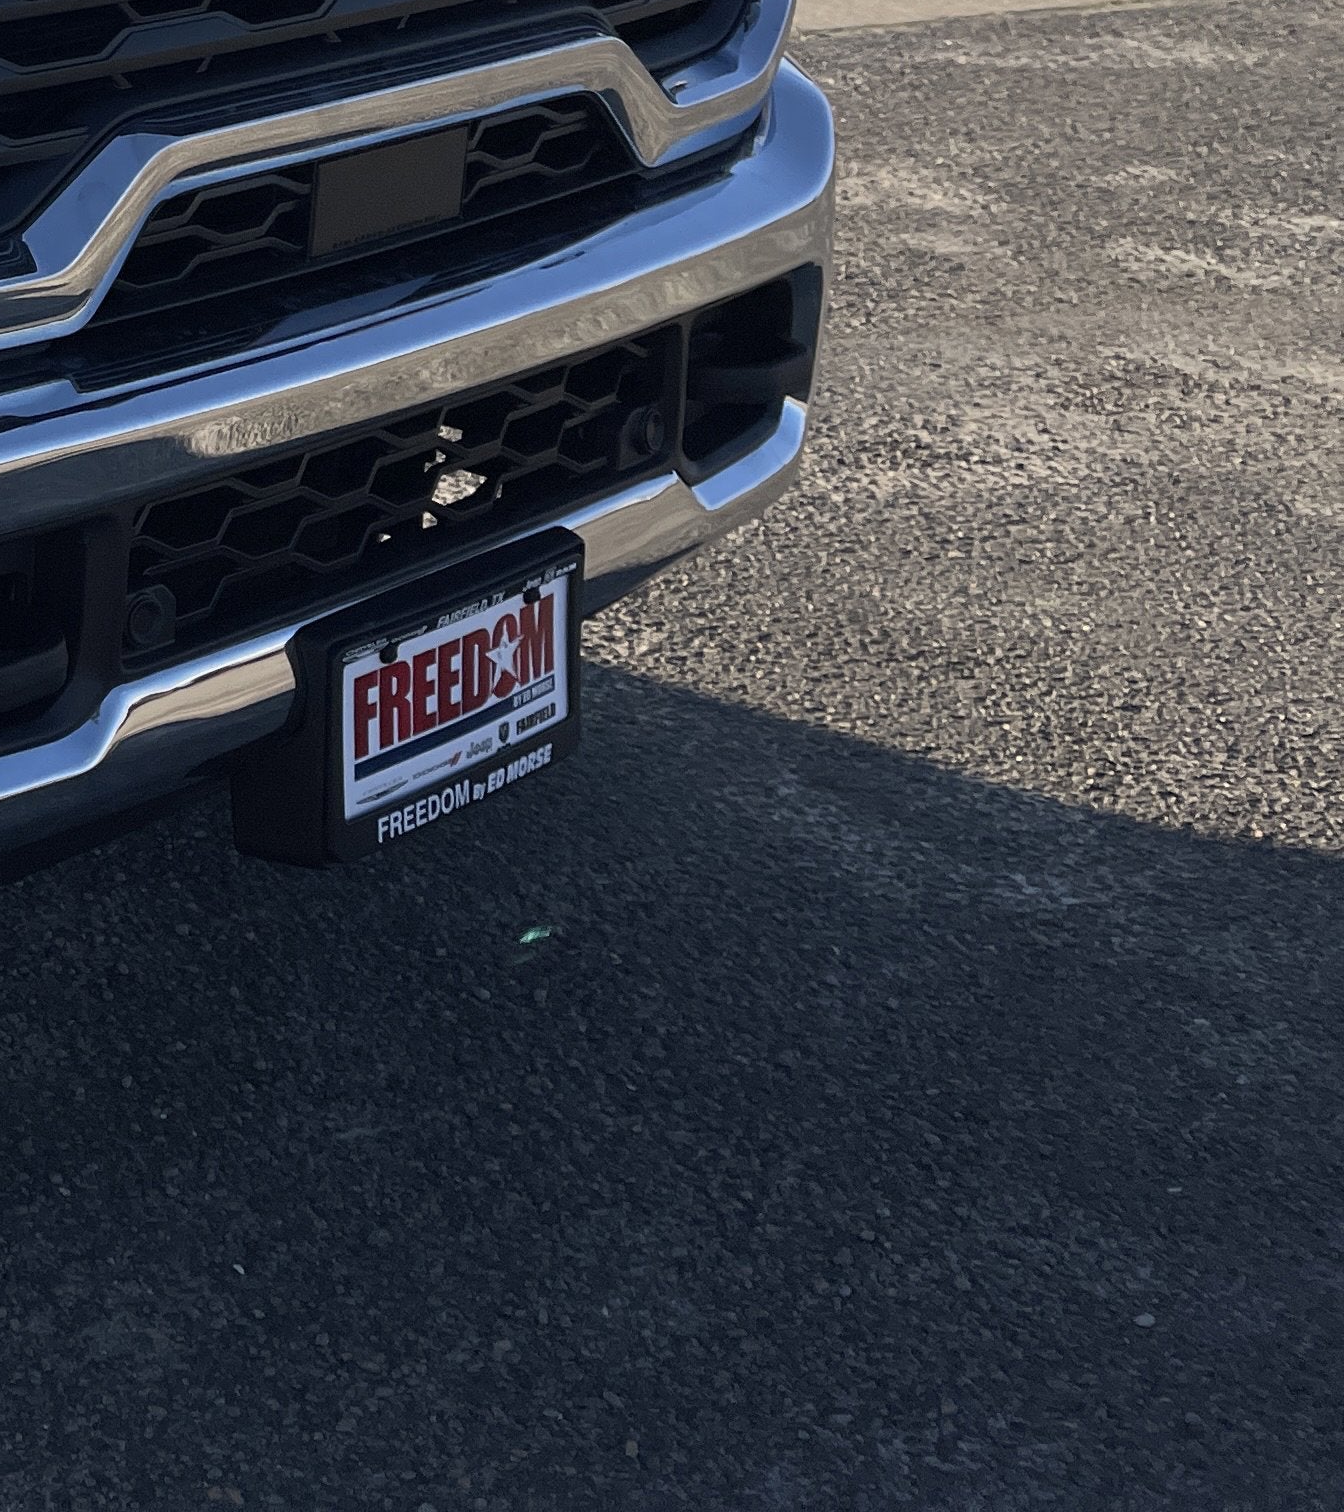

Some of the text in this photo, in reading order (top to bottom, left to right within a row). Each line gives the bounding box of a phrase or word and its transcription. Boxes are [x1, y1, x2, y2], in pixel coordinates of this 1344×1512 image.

[354, 593, 555, 761] FREEDOM
[377, 779, 470, 844] FREEDOM
[487, 767, 506, 794] ED
[506, 742, 553, 785] MORSE
